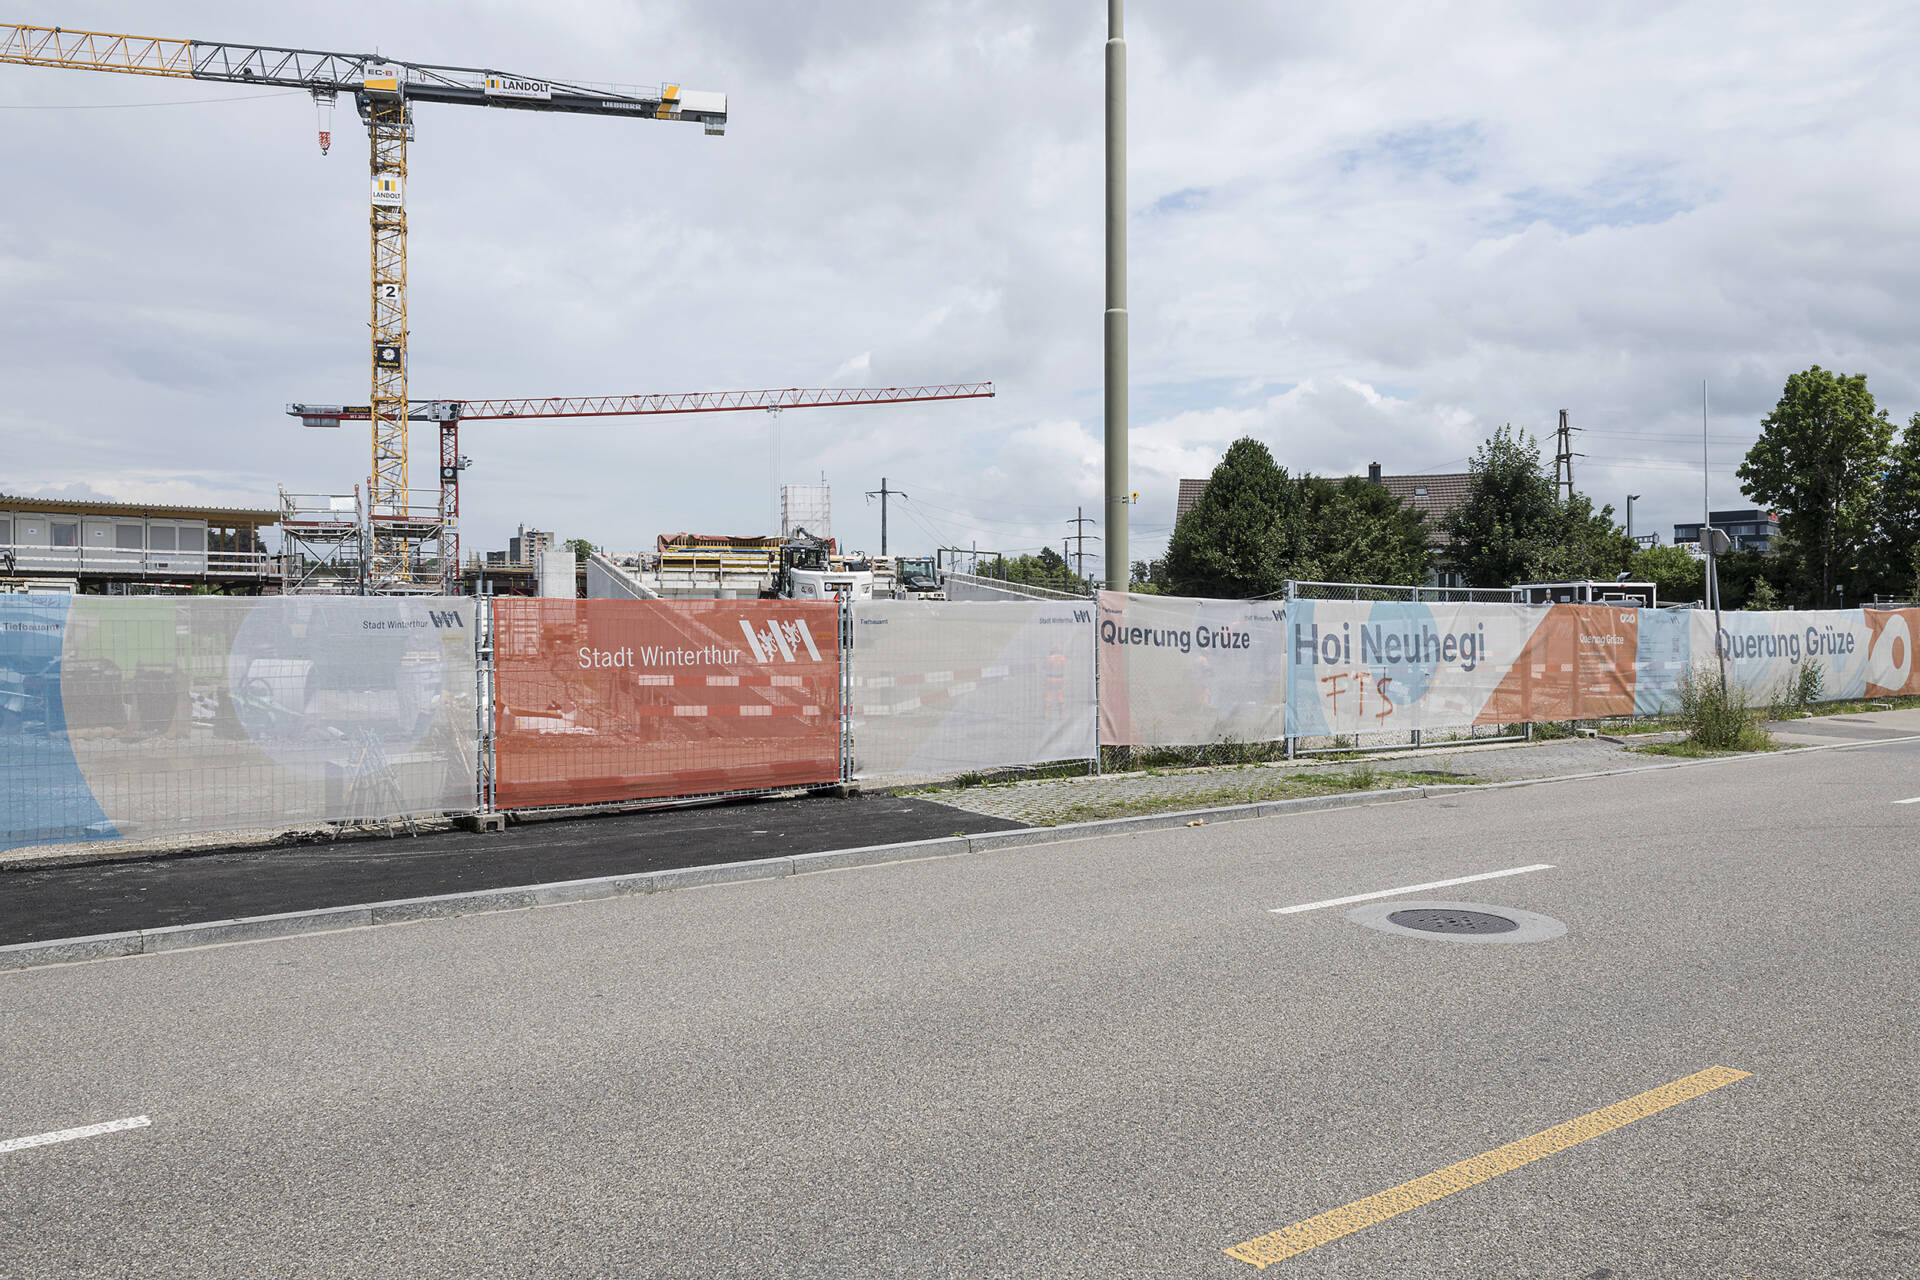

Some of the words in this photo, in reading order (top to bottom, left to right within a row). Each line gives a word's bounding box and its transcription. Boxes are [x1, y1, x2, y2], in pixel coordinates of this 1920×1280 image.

[502, 80, 550, 93] LANDOLT
[373, 191, 401, 199] LANDOLT
[385, 286, 396, 298] 2
[362, 620, 385, 630] Stadt
[387, 620, 428, 629] Winterthur
[1101, 620, 1191, 654] Querung
[1196, 626, 1250, 649] Grüze
[1715, 627, 1801, 665] Querung
[1806, 625, 1855, 655] Grüze
[1295, 622, 1351, 665] Hoi
[1360, 622, 1486, 672] Neuhegi
[579, 646, 634, 668] Stadt
[640, 645, 742, 667] Winterthur
